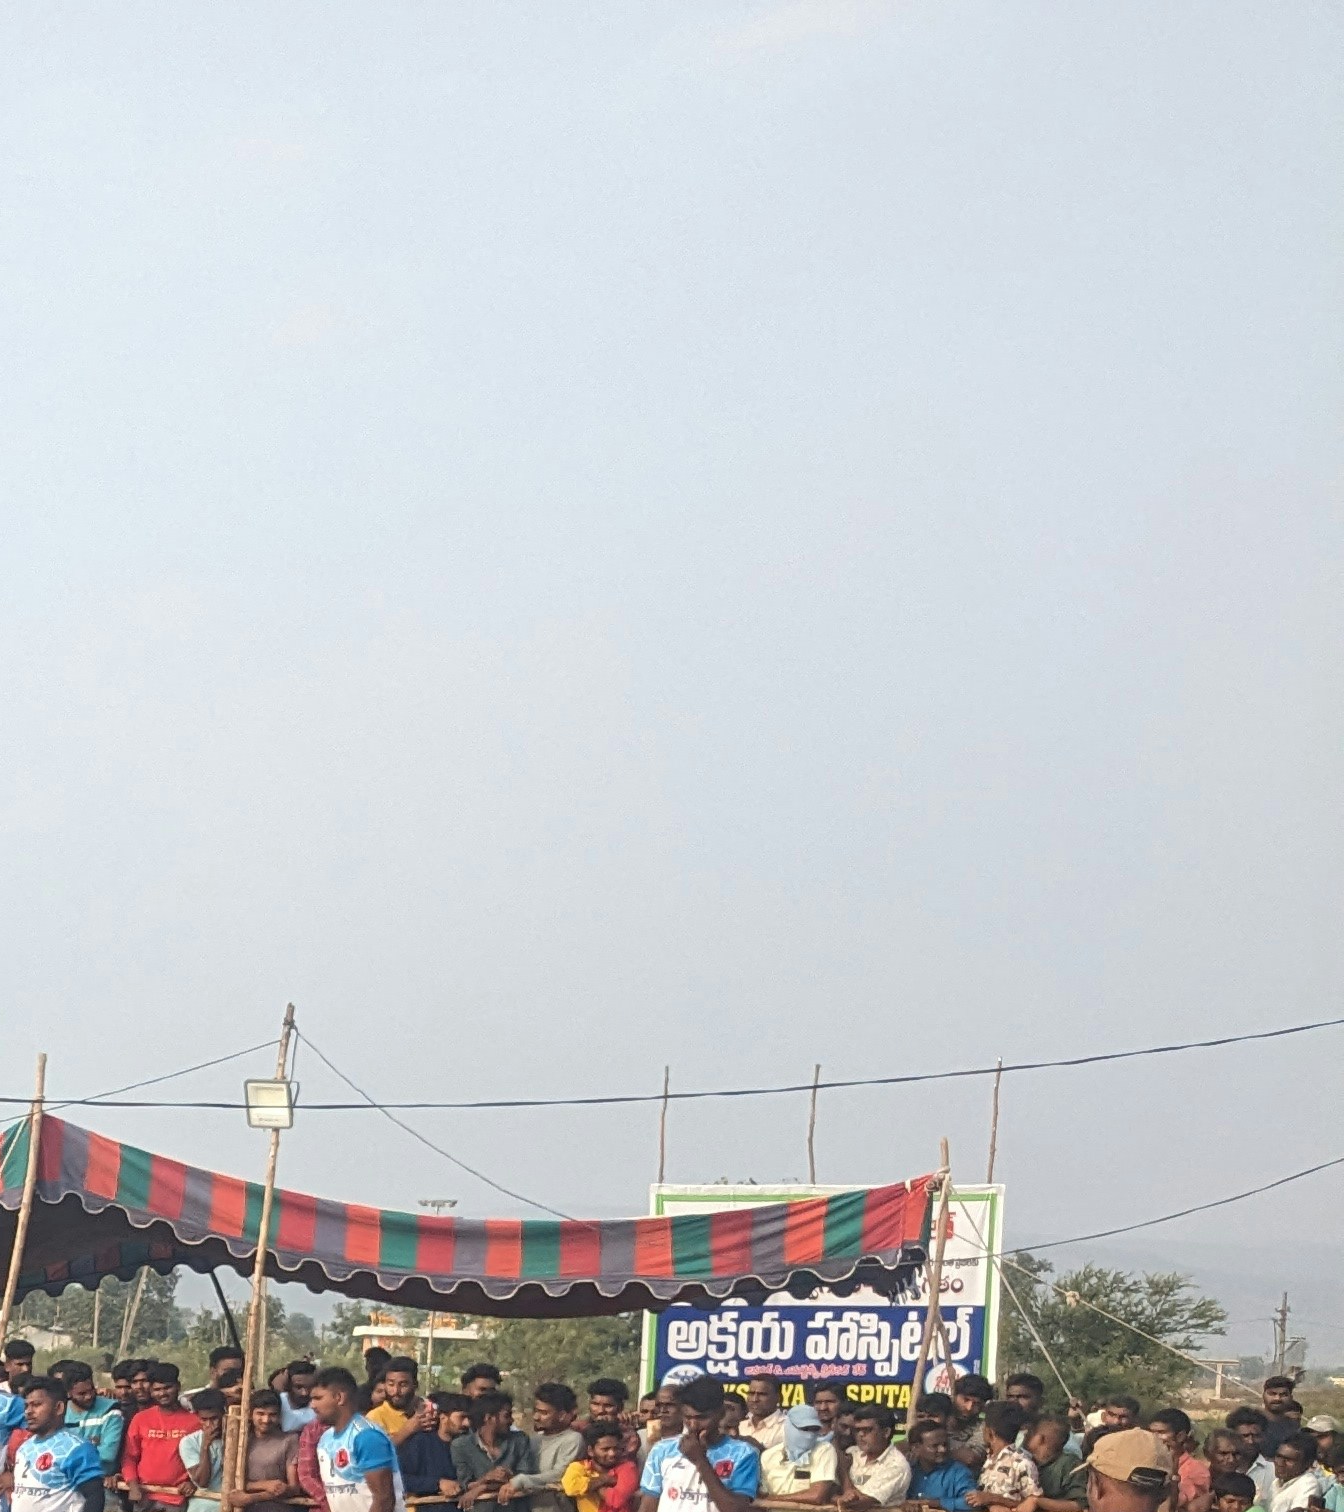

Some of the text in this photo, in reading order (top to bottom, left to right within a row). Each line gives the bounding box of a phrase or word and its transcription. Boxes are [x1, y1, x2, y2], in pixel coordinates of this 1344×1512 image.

[667, 1308, 974, 1378] అక్షయ హాస్పిటల్
[22, 1461, 30, 1479] 2
